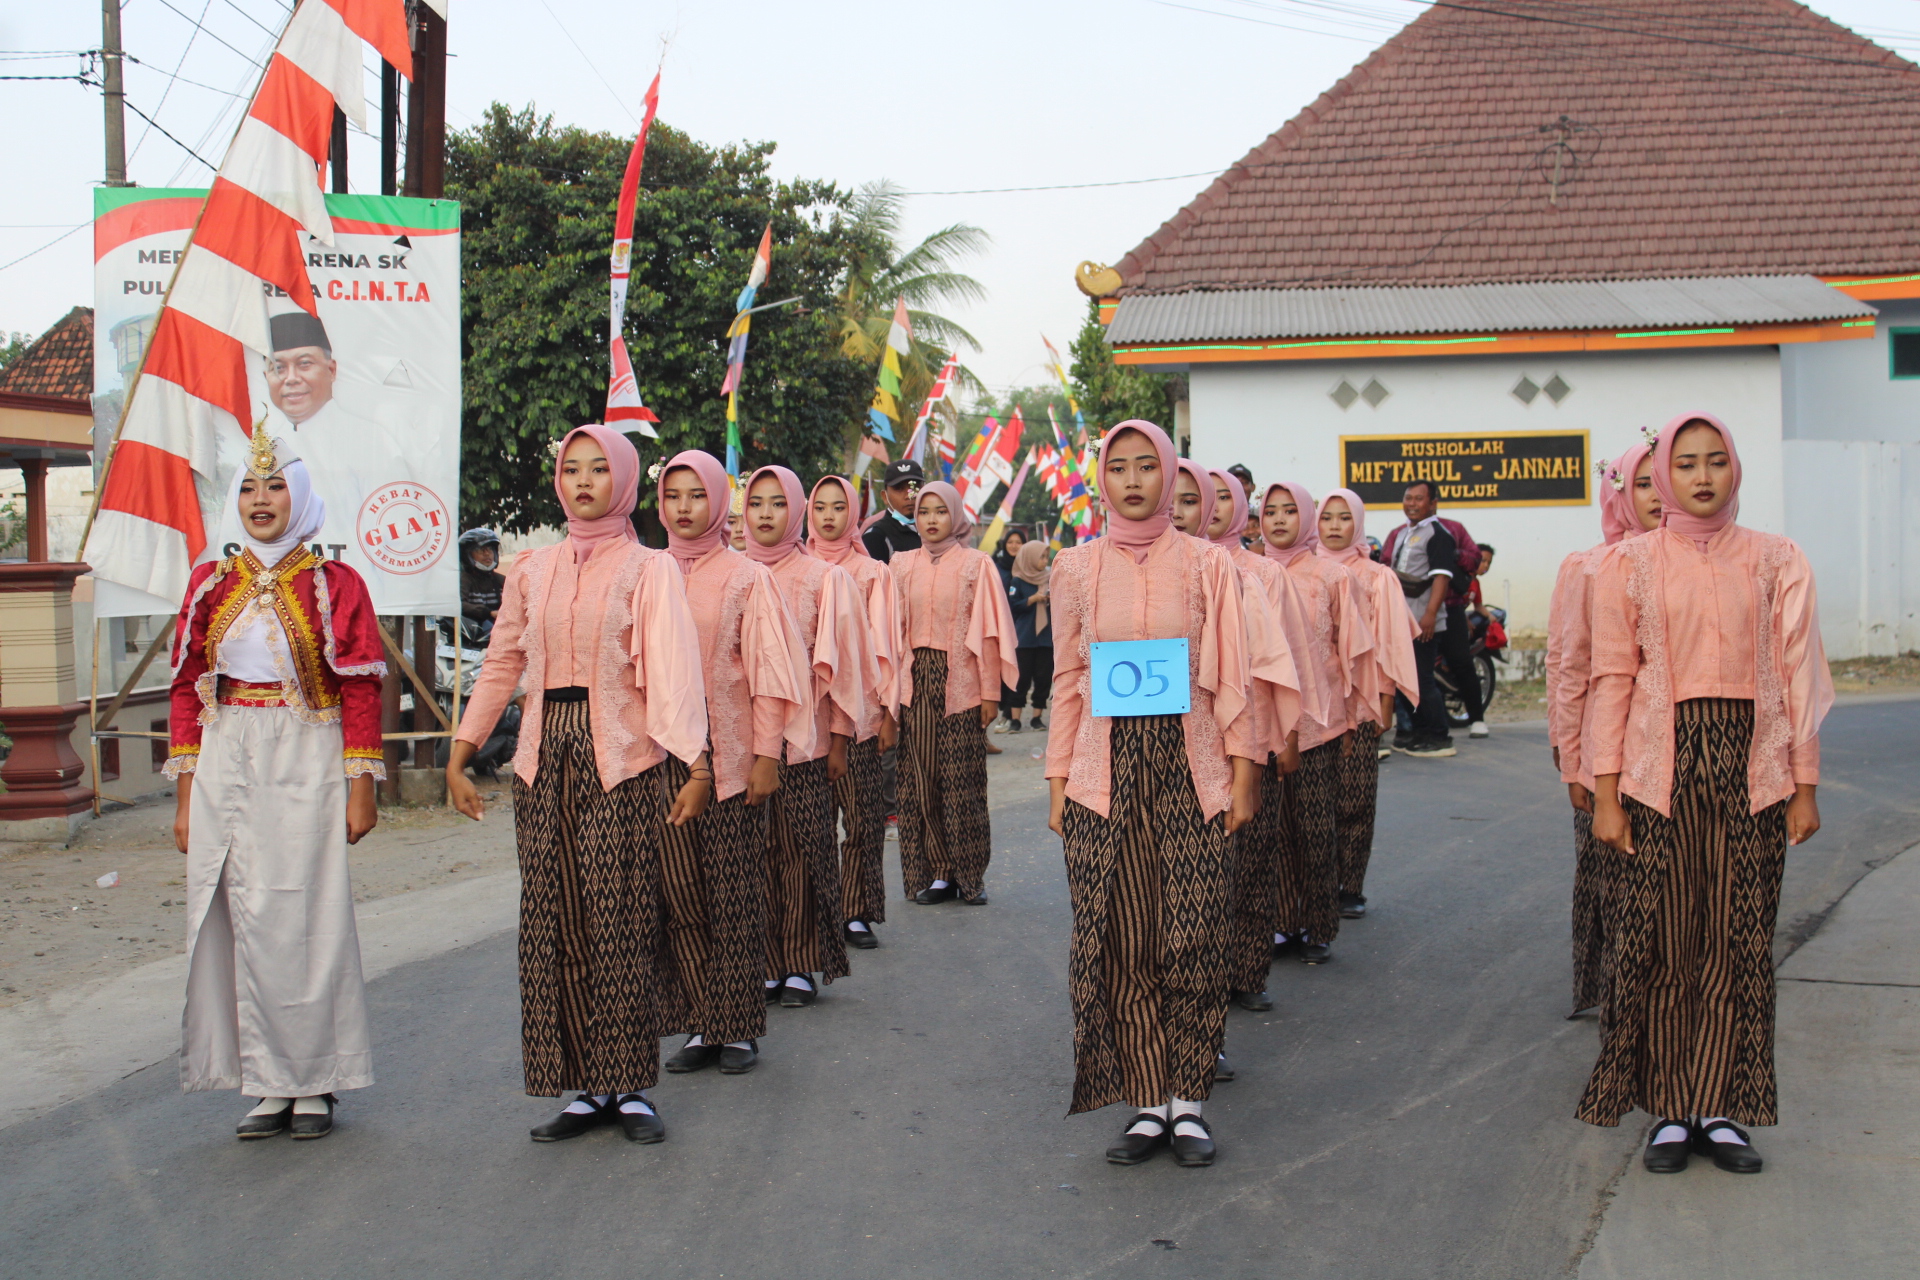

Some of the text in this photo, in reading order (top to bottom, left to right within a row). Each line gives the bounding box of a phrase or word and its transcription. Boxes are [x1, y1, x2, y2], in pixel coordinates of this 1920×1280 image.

[378, 254, 408, 269] SK
[327, 279, 431, 302] C.I.N.T.A
[1401, 440, 1504, 457] MUSHOLLAH
[1350, 459, 1461, 483] MIFTAHUL
[1494, 457, 1581, 480] JANNAH
[369, 489, 422, 514] HEBAT
[365, 509, 441, 547] GIAT
[374, 530, 442, 567] BERMARTABAT
[1107, 659, 1169, 698] 05
